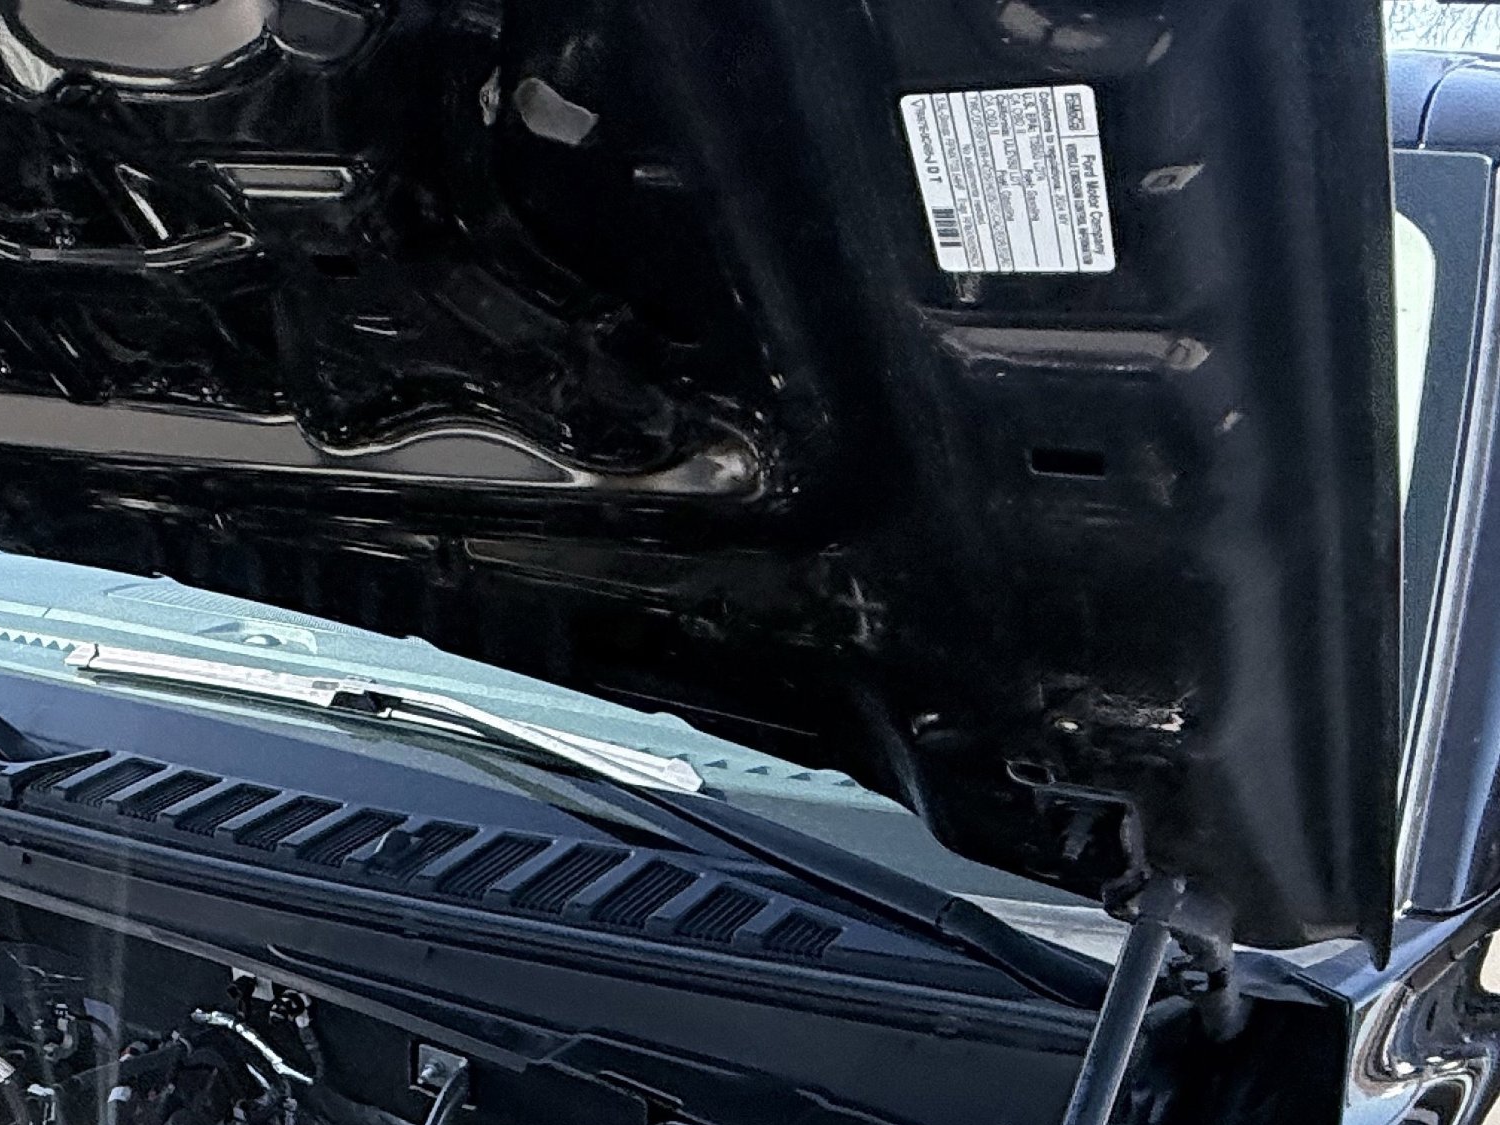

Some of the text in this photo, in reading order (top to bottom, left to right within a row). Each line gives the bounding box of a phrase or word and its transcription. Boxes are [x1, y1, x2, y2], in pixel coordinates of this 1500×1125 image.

[1081, 154, 1107, 255] Ford Motor Company
